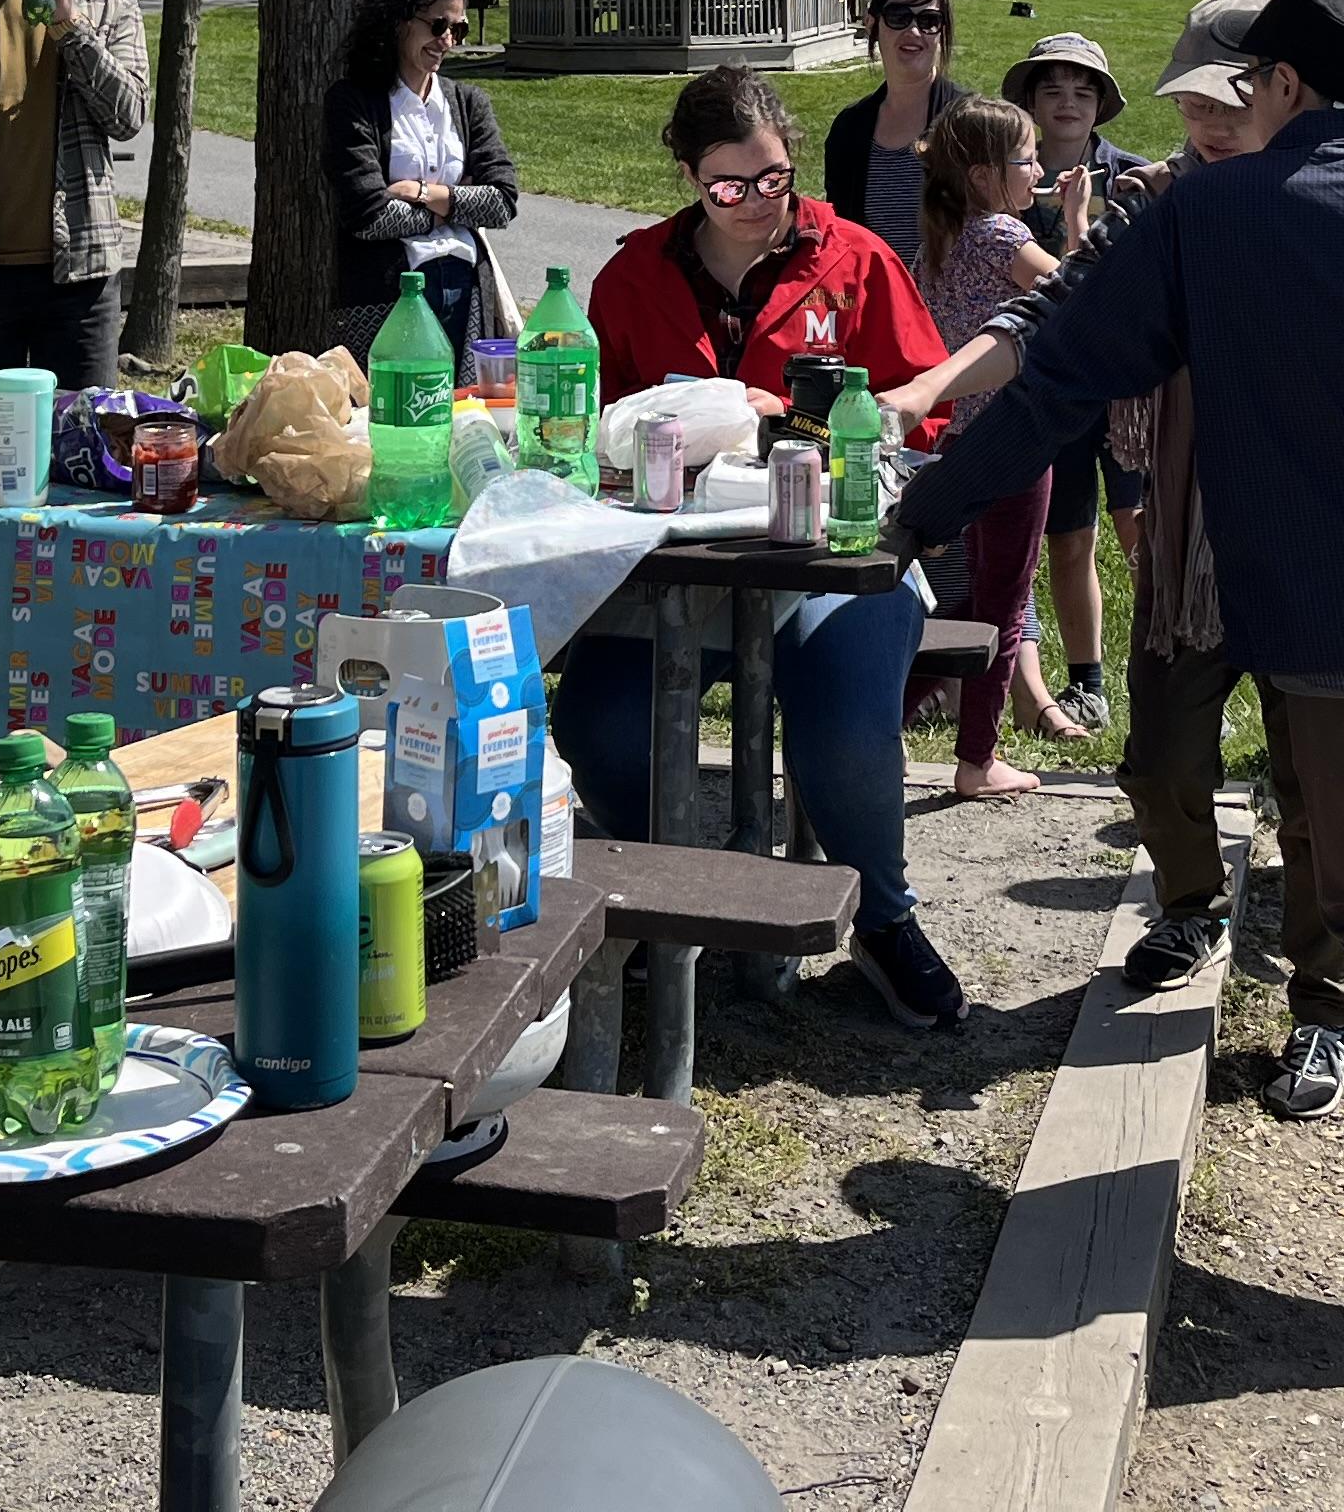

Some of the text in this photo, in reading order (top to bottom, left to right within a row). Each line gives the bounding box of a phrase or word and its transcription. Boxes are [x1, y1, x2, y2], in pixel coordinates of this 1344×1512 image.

[804, 310, 838, 343] M
[412, 387, 450, 409] Sprite
[790, 415, 830, 438] Nikon
[34, 526, 58, 603] VIBES
[71, 539, 156, 565] MODE
[71, 565, 153, 588] VACAY
[170, 557, 193, 635] VIBES
[193, 538, 217, 656] SUMMER
[241, 561, 264, 653] VACAY
[262, 563, 288, 655] MODE
[71, 608, 94, 698] VACAY
[92, 609, 116, 700] MODE
[292, 590, 317, 686] VACAY
[8, 650, 29, 732] MMER
[136, 671, 245, 696] SUMMER
[29, 671, 49, 732] IBES
[154, 697, 225, 719] VIBES
[399, 735, 441, 755] EVERYDAY
[483, 736, 524, 754] EVERYDAY
[5, 1017, 31, 1031] ALE
[255, 1057, 311, 1073] contigo
